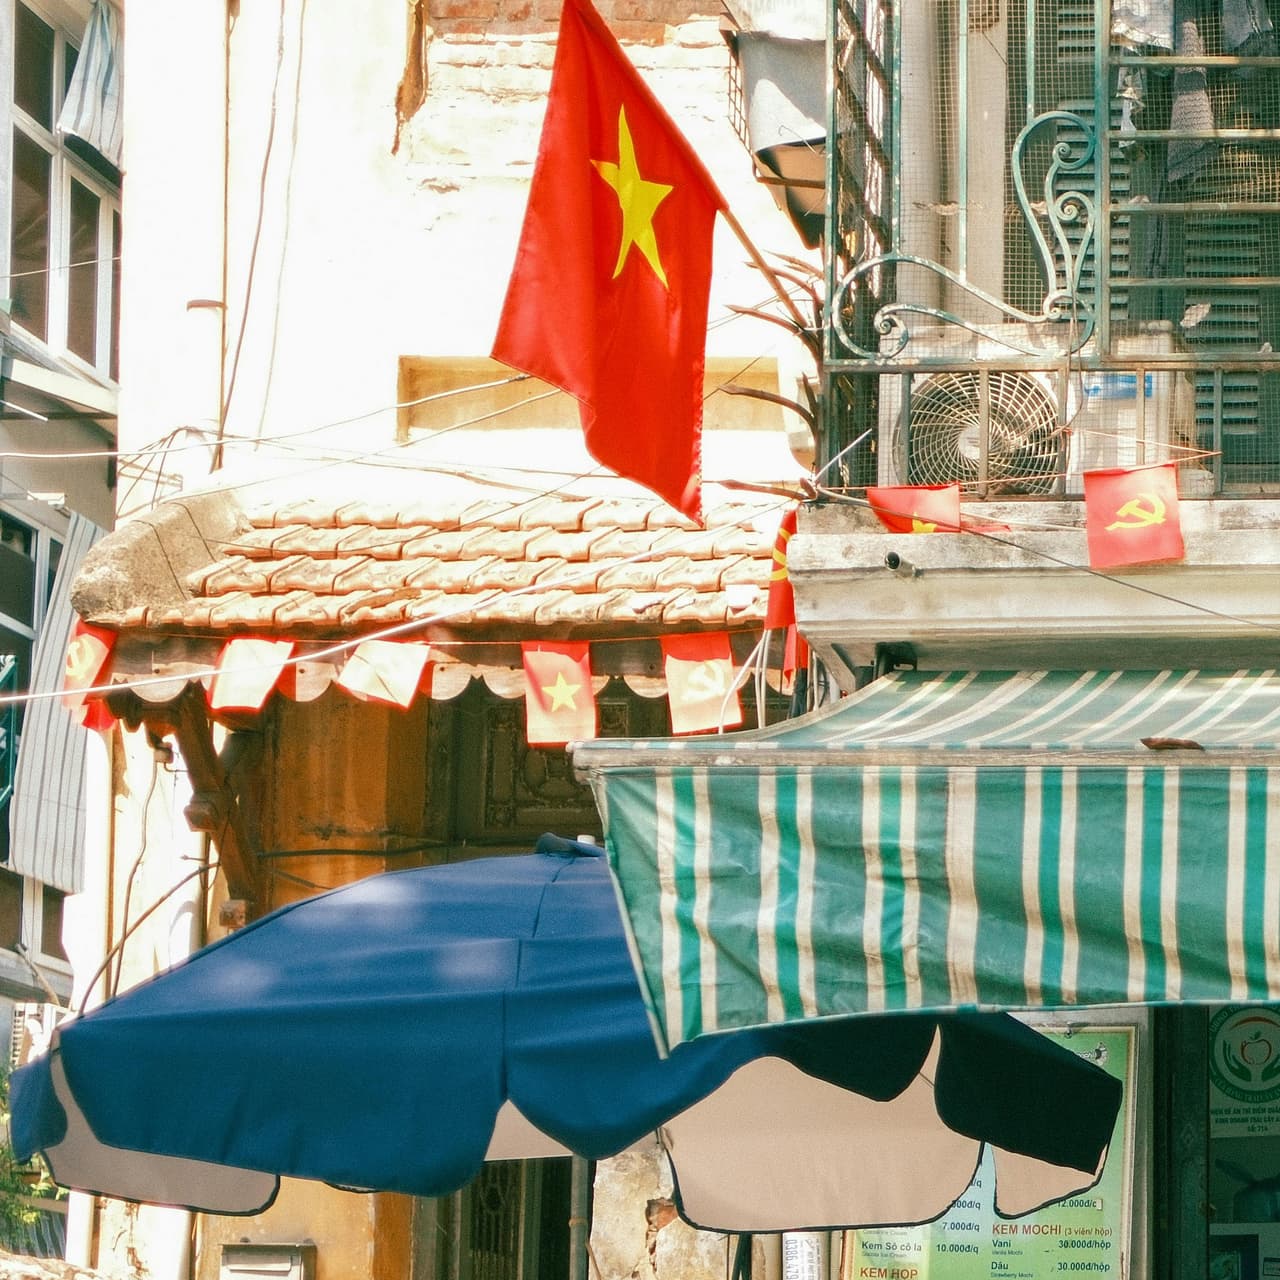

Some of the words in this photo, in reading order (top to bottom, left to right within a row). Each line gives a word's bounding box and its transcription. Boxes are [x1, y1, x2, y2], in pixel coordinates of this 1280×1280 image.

[992, 1225, 1018, 1235] KEM
[1022, 1224, 1061, 1235] MOCHI
[861, 1241, 883, 1250] Kem
[936, 1244, 979, 1254] 10.000đ/q
[1058, 1240, 1111, 1250] 30.000đ/hộp
[991, 1261, 1009, 1270] Dâu
[1057, 1262, 1110, 1273] 30.000đ/hộp
[860, 1267, 887, 1278] KEM
